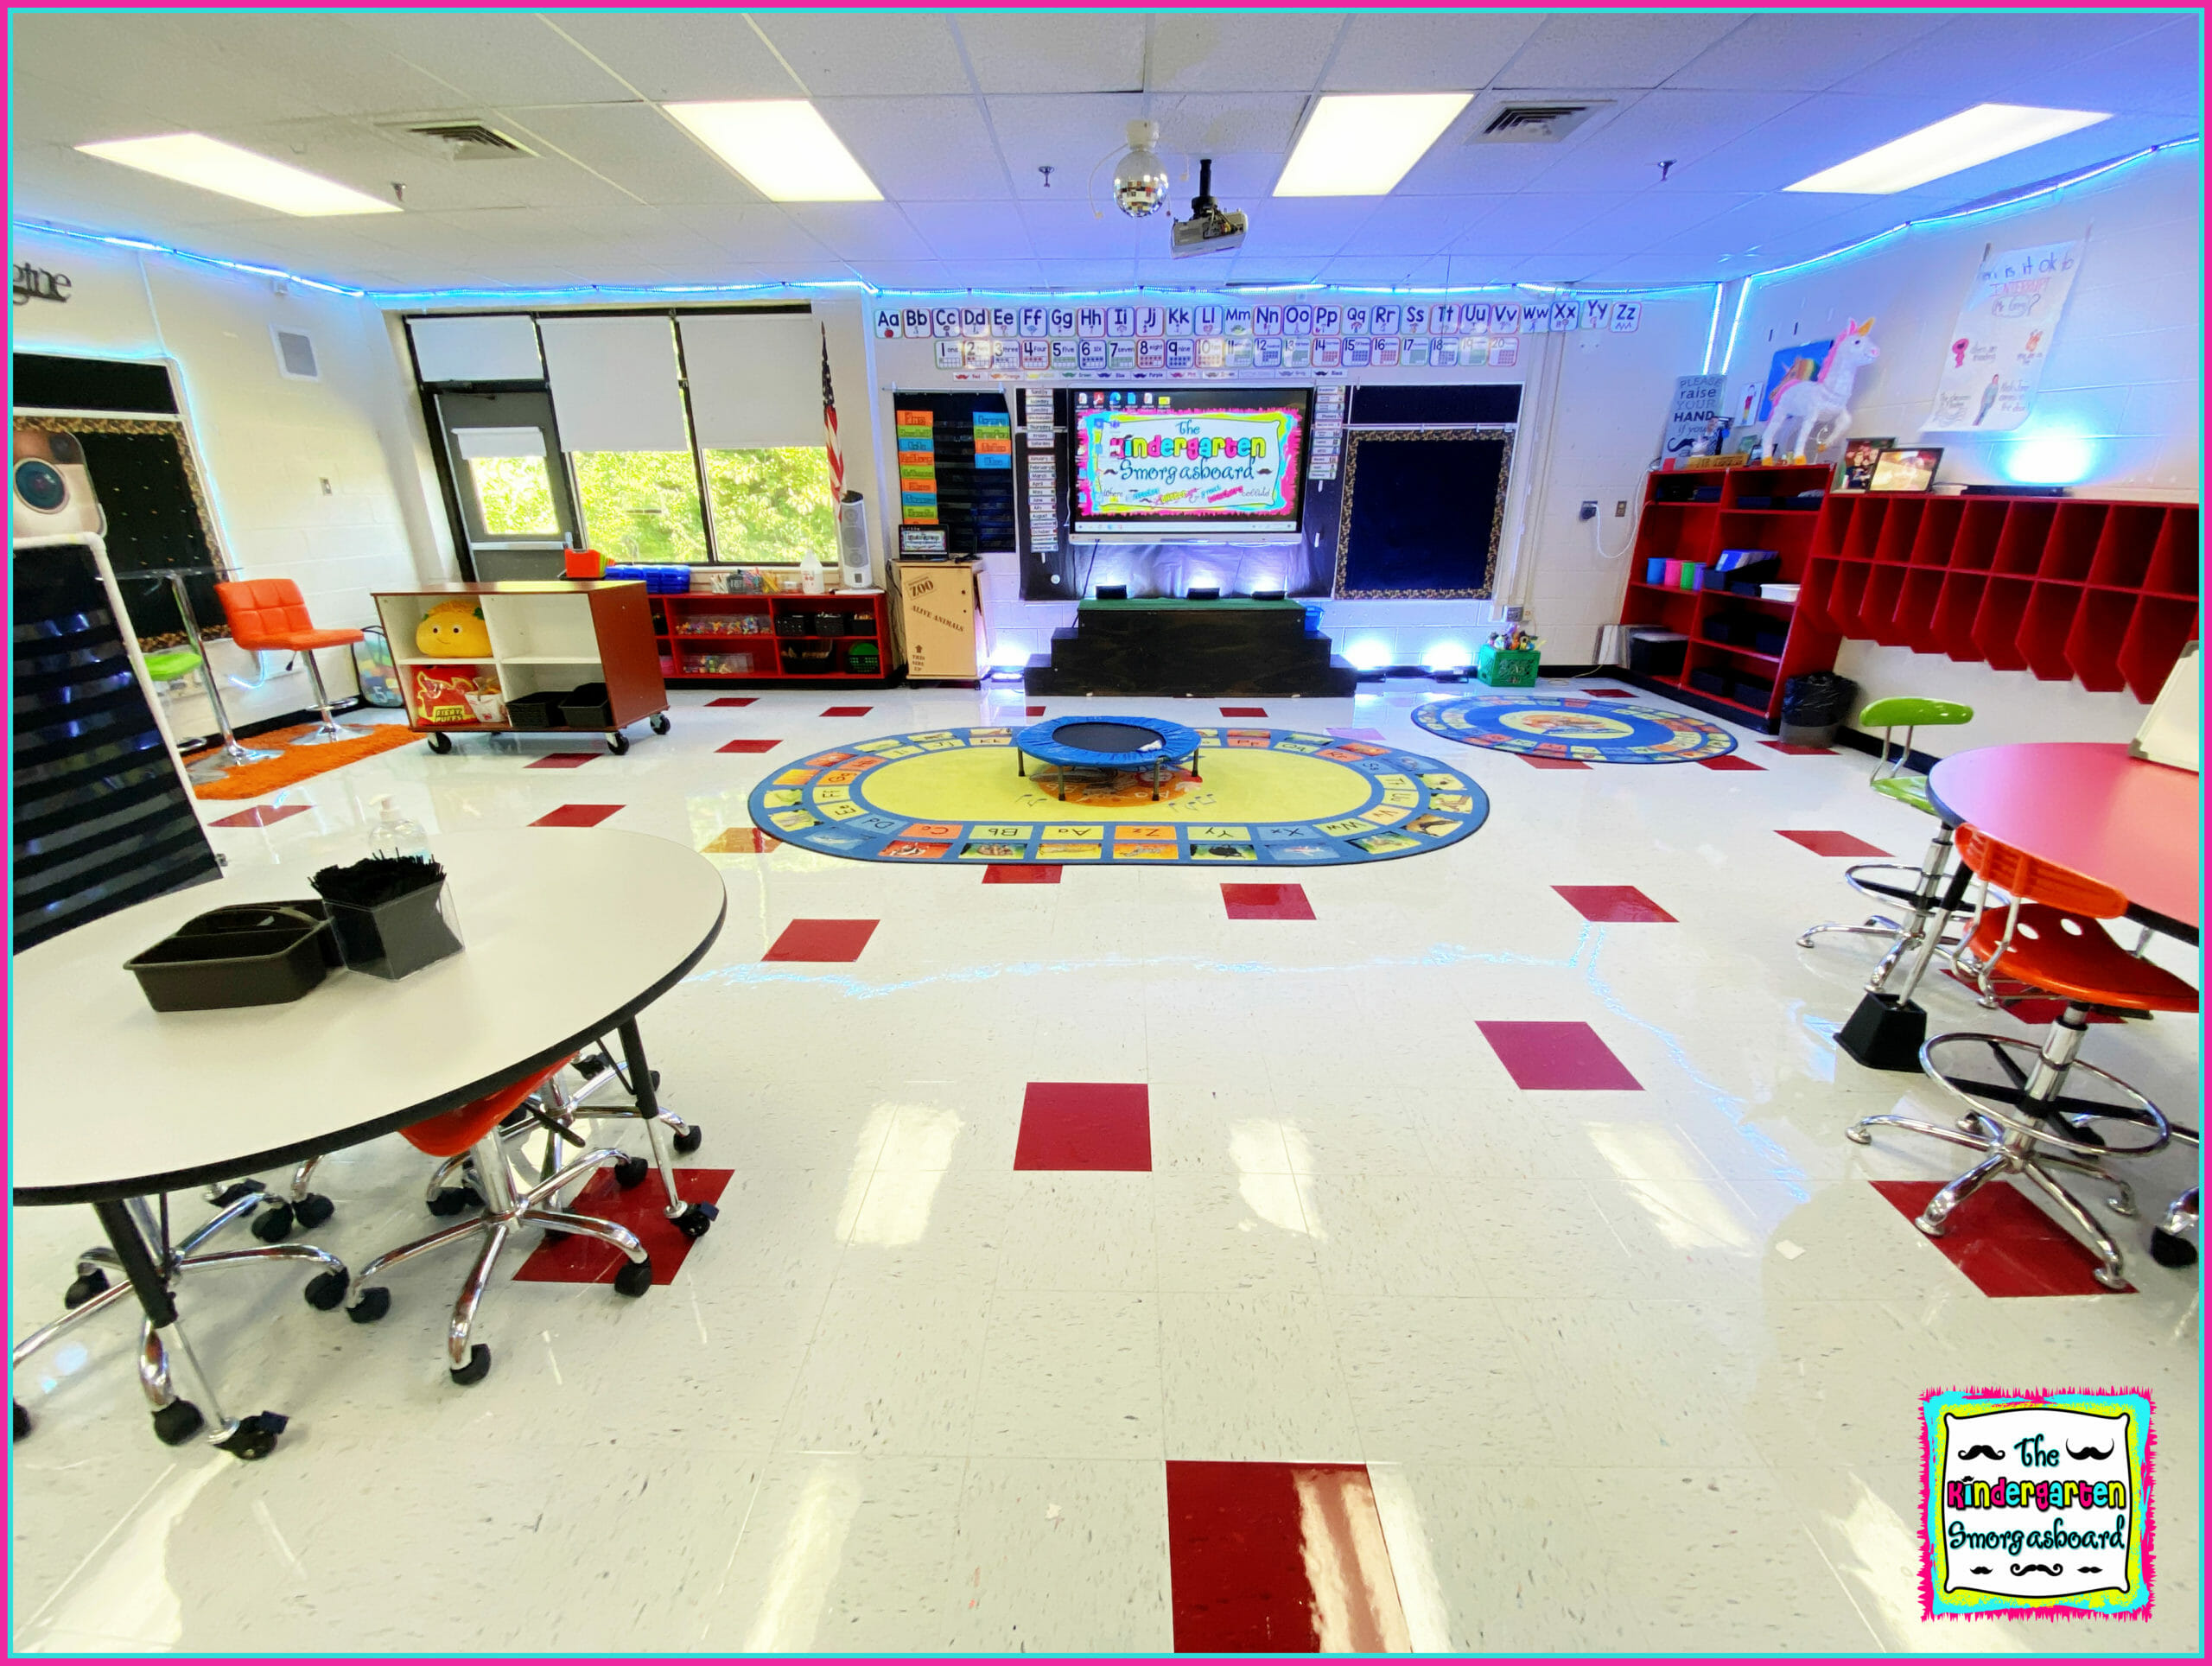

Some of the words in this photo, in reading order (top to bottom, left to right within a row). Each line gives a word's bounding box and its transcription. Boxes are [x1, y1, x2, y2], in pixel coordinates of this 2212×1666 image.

[878, 311, 899, 327] Aa
[906, 309, 927, 326] Bb
[937, 309, 956, 325] Cc
[964, 309, 985, 325] Dd
[995, 309, 1014, 325] Ee
[1024, 309, 1042, 325] Ff
[1052, 308, 1072, 328] Gg
[1082, 309, 1101, 325] Hh
[1115, 309, 1127, 324] Ii
[1144, 308, 1156, 327] Jj
[1169, 308, 1189, 324] Kk
[1203, 308, 1215, 323] Ll
[1226, 308, 1250, 321] Mm
[1256, 308, 1278, 323] Nn
[1286, 307, 1309, 323] Oo
[1316, 308, 1338, 327] Pp
[1347, 308, 1365, 322] Qq
[1376, 307, 1395, 323] Rr
[1407, 306, 1424, 322] Ss
[1465, 306, 1485, 321] Uu
[1496, 306, 1517, 321] Vv
[1524, 306, 1549, 319] Ww
[1554, 303, 1576, 319] Xx
[1588, 300, 1607, 320] Yy
[1617, 304, 1636, 320] Zz
[941, 343, 945, 357] 1
[968, 341, 975, 356] 2
[995, 343, 1003, 356] 3
[1024, 341, 1033, 356] 4
[1053, 343, 1061, 356] 5
[1082, 342, 1090, 356] 6
[1110, 343, 1118, 358] 7
[1141, 341, 1148, 354] 8
[1169, 341, 1177, 356] 9
[1198, 340, 1210, 354] 10
[1228, 340, 1234, 354] 11
[1257, 340, 1266, 351] 12
[1286, 340, 1294, 351] 13
[1315, 340, 1325, 351] 14
[1345, 340, 1355, 351] 15
[1375, 339, 1385, 350] 16
[1403, 339, 1414, 351] 17
[1433, 339, 1443, 351] 18
[1463, 339, 1473, 350] 19
[1491, 339, 1504, 349] 20
[1680, 377, 1723, 388] PLEASE
[1680, 387, 1716, 399] raise
[1677, 399, 1715, 410] YOUR
[1675, 410, 1714, 422] HAND
[1176, 420, 1200, 435] The
[1110, 435, 1266, 459] Kindergarten
[1120, 456, 1255, 485] Smorgasboard
[910, 580, 933, 596] ZOO
[912, 605, 932, 618] ALIVE
[933, 614, 963, 632] ANIMALS
[988, 828, 1019, 836] Bb
[1058, 828, 1091, 836] Aa
[1133, 828, 1160, 836] Zz
[1205, 826, 1233, 838] Yy
[1271, 828, 1304, 836] Xx
